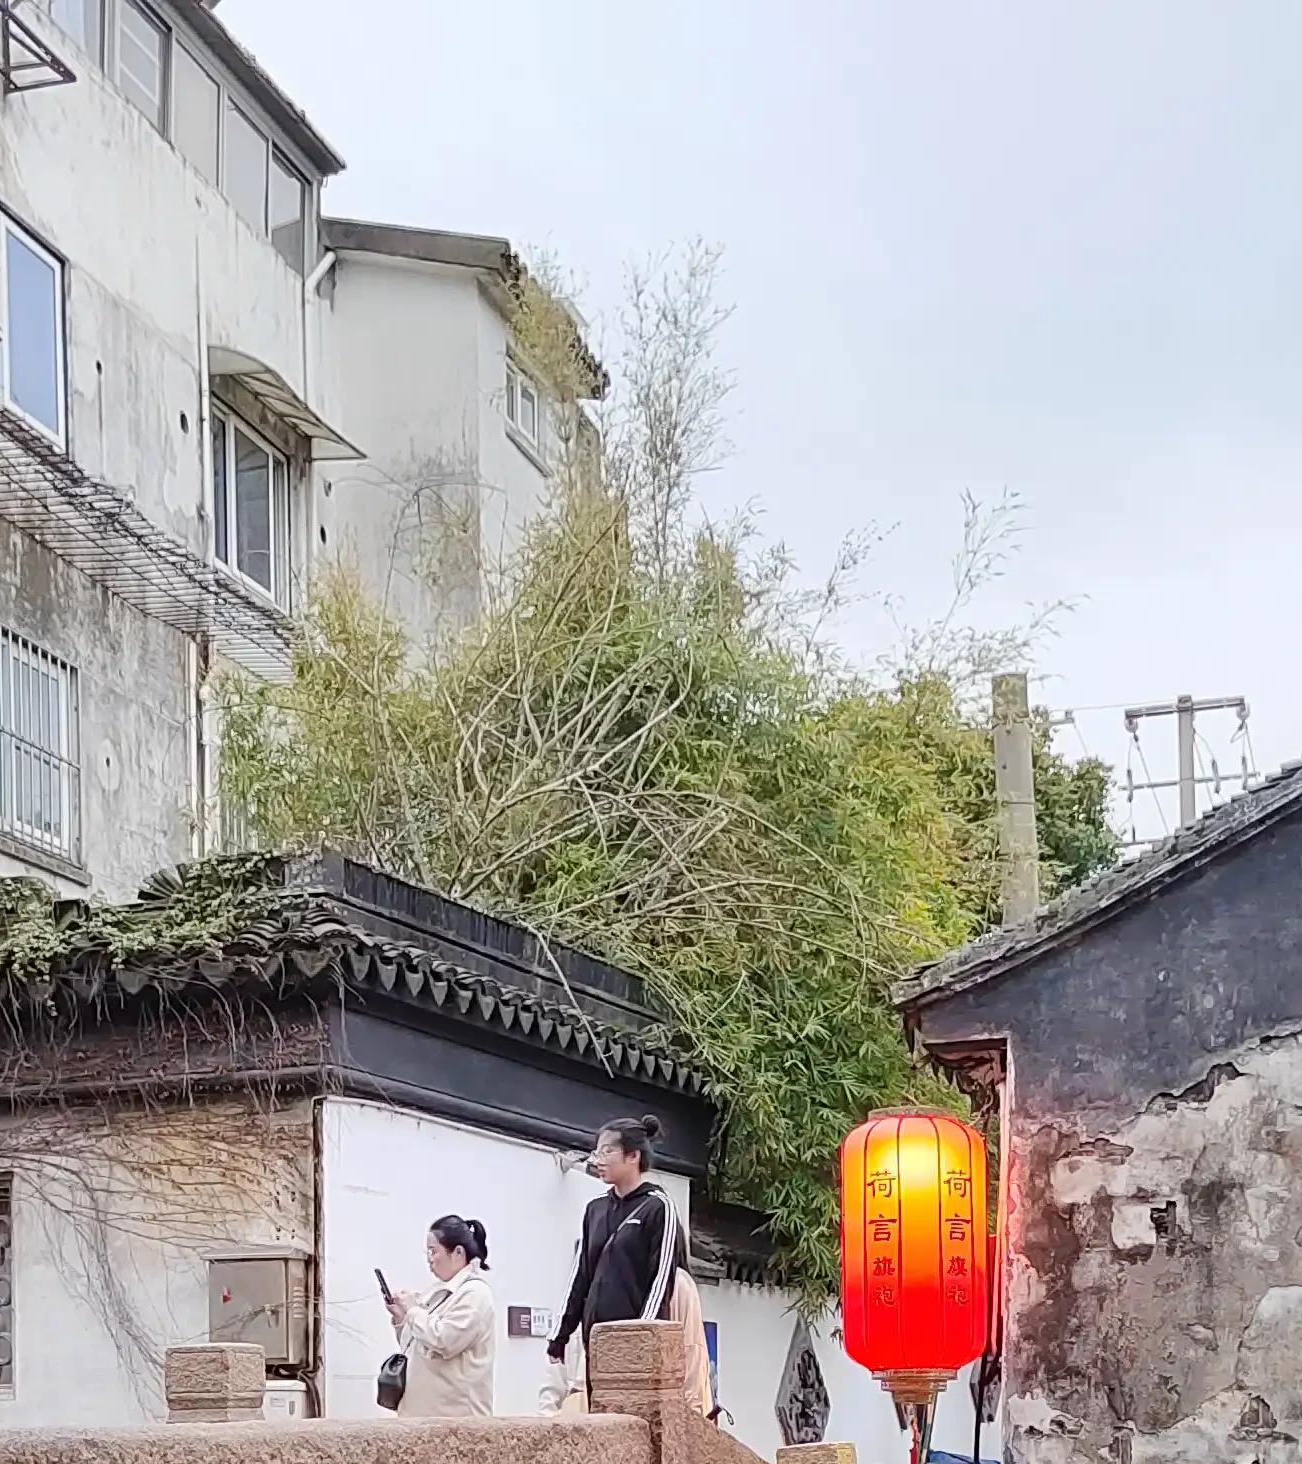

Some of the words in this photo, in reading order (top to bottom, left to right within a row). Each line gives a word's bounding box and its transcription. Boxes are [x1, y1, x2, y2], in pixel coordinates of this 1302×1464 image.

[867, 1169, 898, 1306] 荷言旗袍
[943, 1169, 971, 1306] 荷言旗袍
